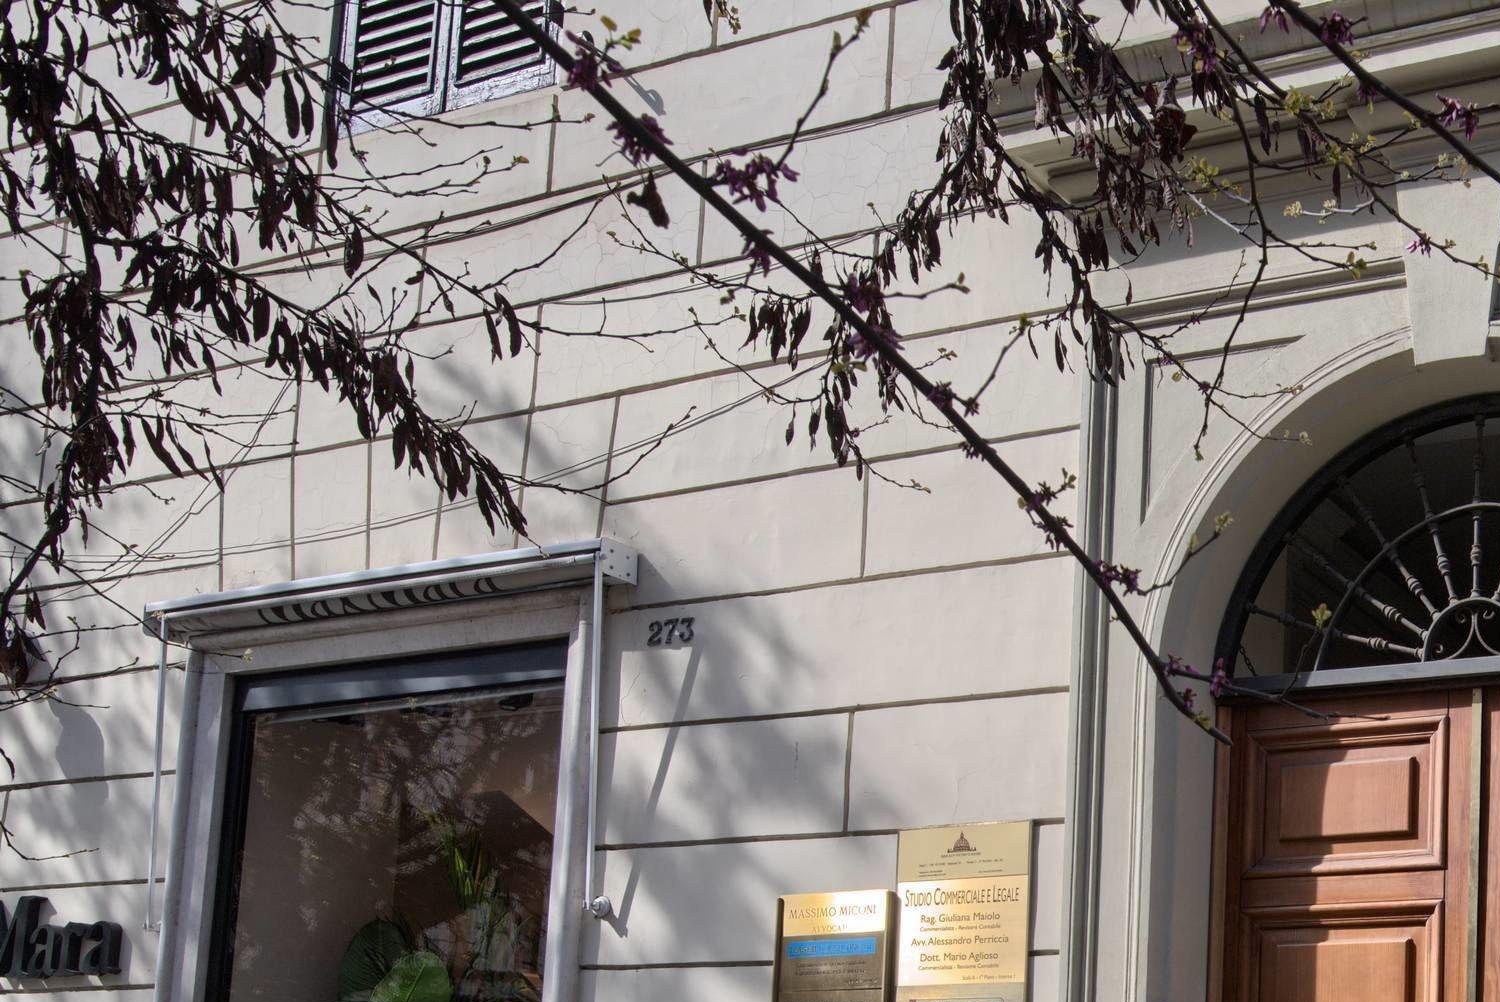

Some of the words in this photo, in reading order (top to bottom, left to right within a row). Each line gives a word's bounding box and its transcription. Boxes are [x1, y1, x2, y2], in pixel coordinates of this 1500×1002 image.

[647, 616, 696, 647] 273
[905, 889, 932, 907] STUDIO
[934, 887, 985, 905] COMMERCIALE
[992, 886, 1020, 902] LEGALE
[789, 906, 837, 919] MASSIMO
[928, 936, 972, 946] Alessandro
